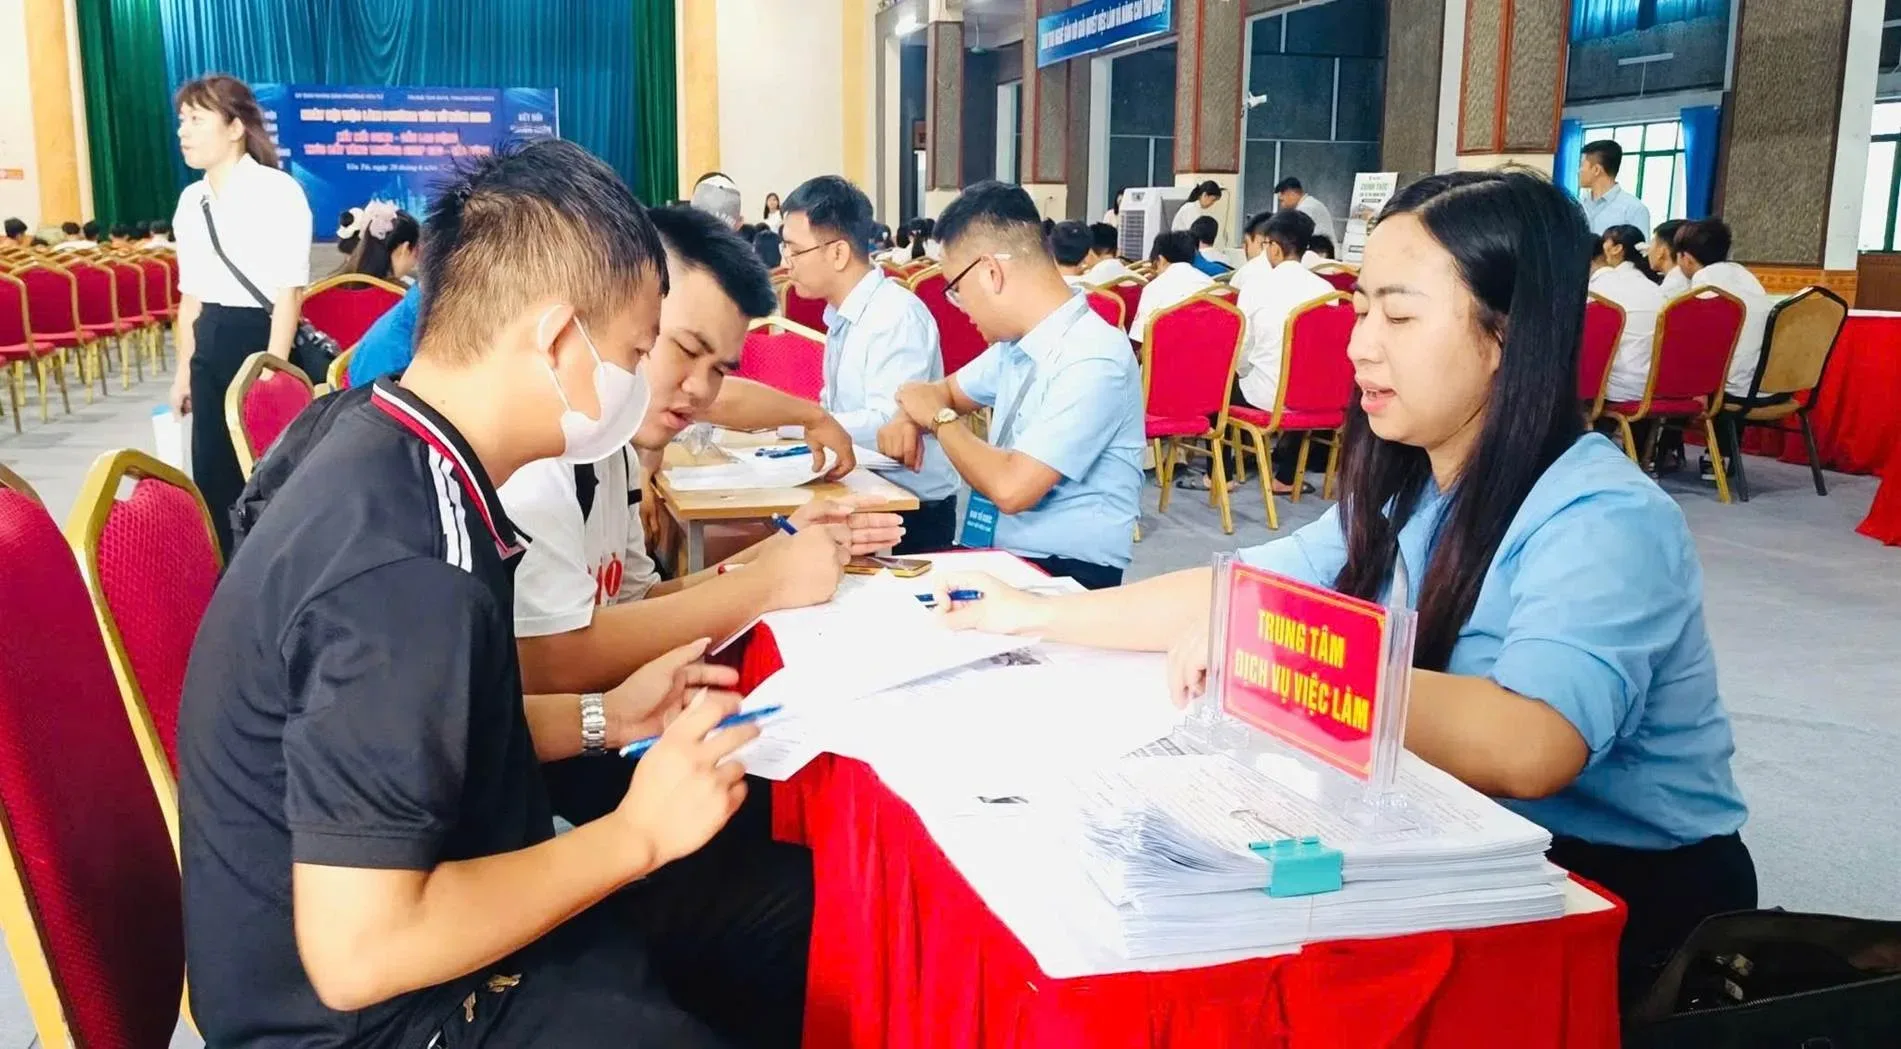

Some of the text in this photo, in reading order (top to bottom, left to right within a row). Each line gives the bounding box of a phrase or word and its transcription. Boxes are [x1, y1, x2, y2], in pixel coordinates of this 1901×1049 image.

[1258, 610, 1346, 669] TRUNG TÂM
[1235, 649, 1370, 732] DỊCH VỤ VIỆC LÀM
